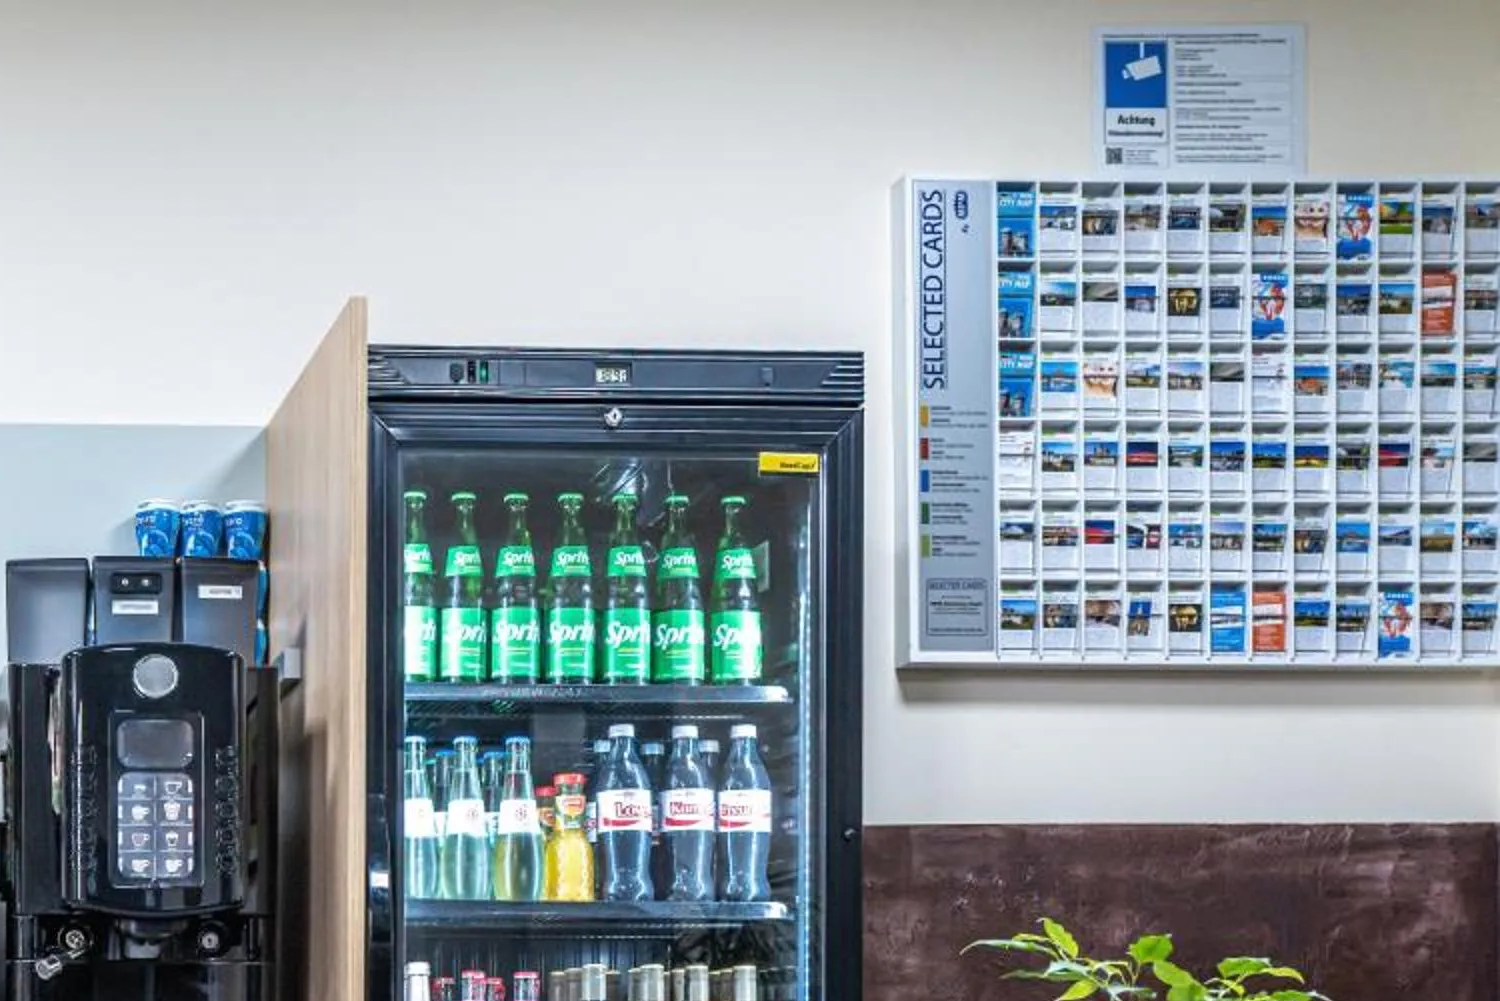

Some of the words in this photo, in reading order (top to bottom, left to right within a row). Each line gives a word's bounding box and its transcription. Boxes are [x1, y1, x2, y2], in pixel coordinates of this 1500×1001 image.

[1117, 115, 1156, 127] Achtung
[923, 189, 944, 269] CARDS
[923, 275, 944, 389] SELECTED
